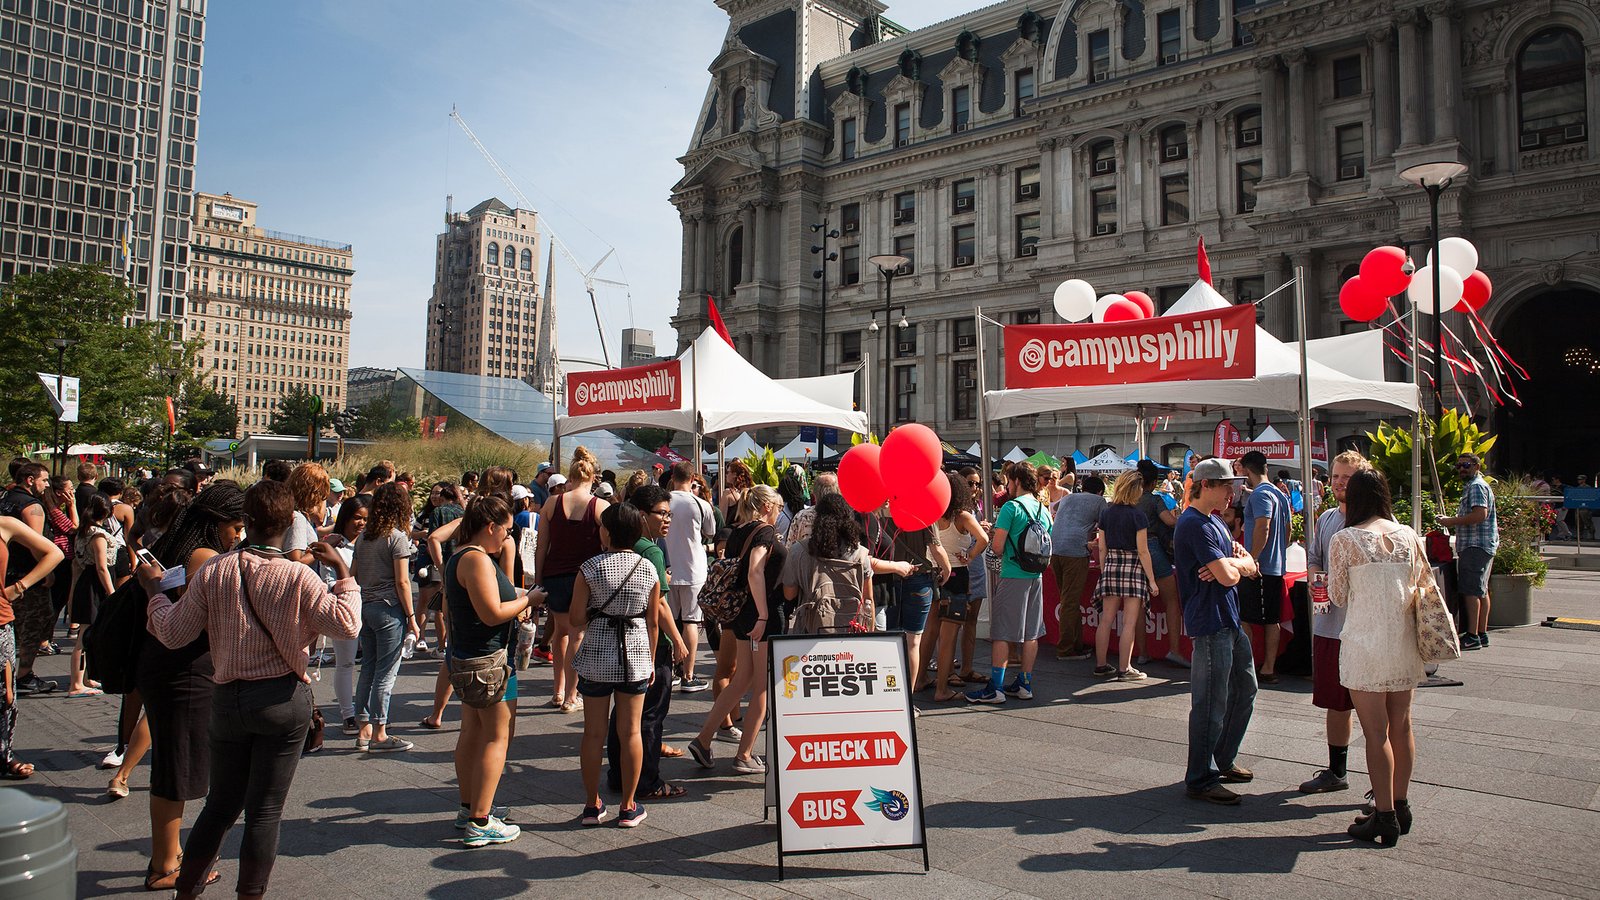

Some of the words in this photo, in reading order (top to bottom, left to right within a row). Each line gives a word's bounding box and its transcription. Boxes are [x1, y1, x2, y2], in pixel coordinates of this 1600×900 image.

[1048, 318, 1239, 373] campusphilly
[589, 369, 675, 406] campusphilly
[801, 662, 878, 677] COLLEGE
[808, 652, 854, 663] campusphilly
[802, 674, 878, 698] FEST
[799, 739, 870, 763] CHECK
[874, 738, 896, 759] IN
[803, 798, 847, 821] BUS
